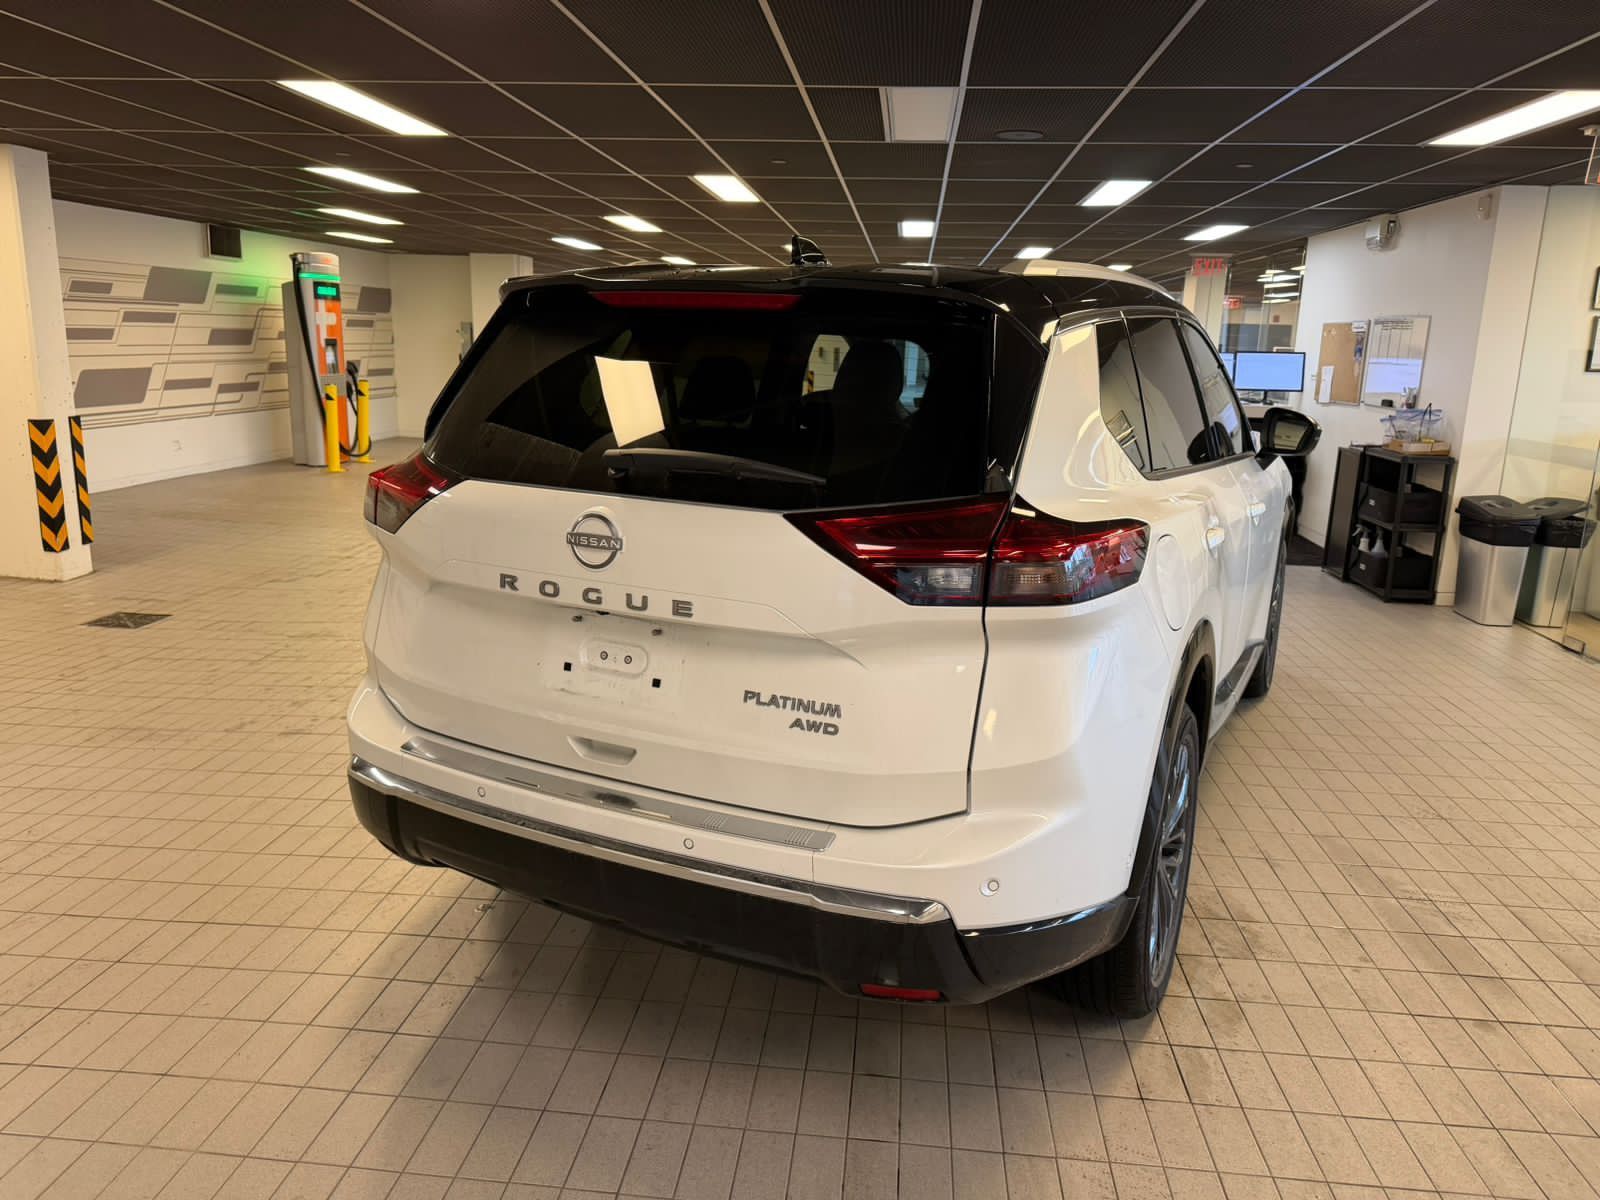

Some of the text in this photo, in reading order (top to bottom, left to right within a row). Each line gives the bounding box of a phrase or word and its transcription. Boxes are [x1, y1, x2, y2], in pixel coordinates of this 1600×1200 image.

[568, 534, 621, 550] NISSAN
[499, 573, 694, 617] ROGUE
[743, 690, 842, 718] PLATINUM
[789, 719, 839, 736] AWD
